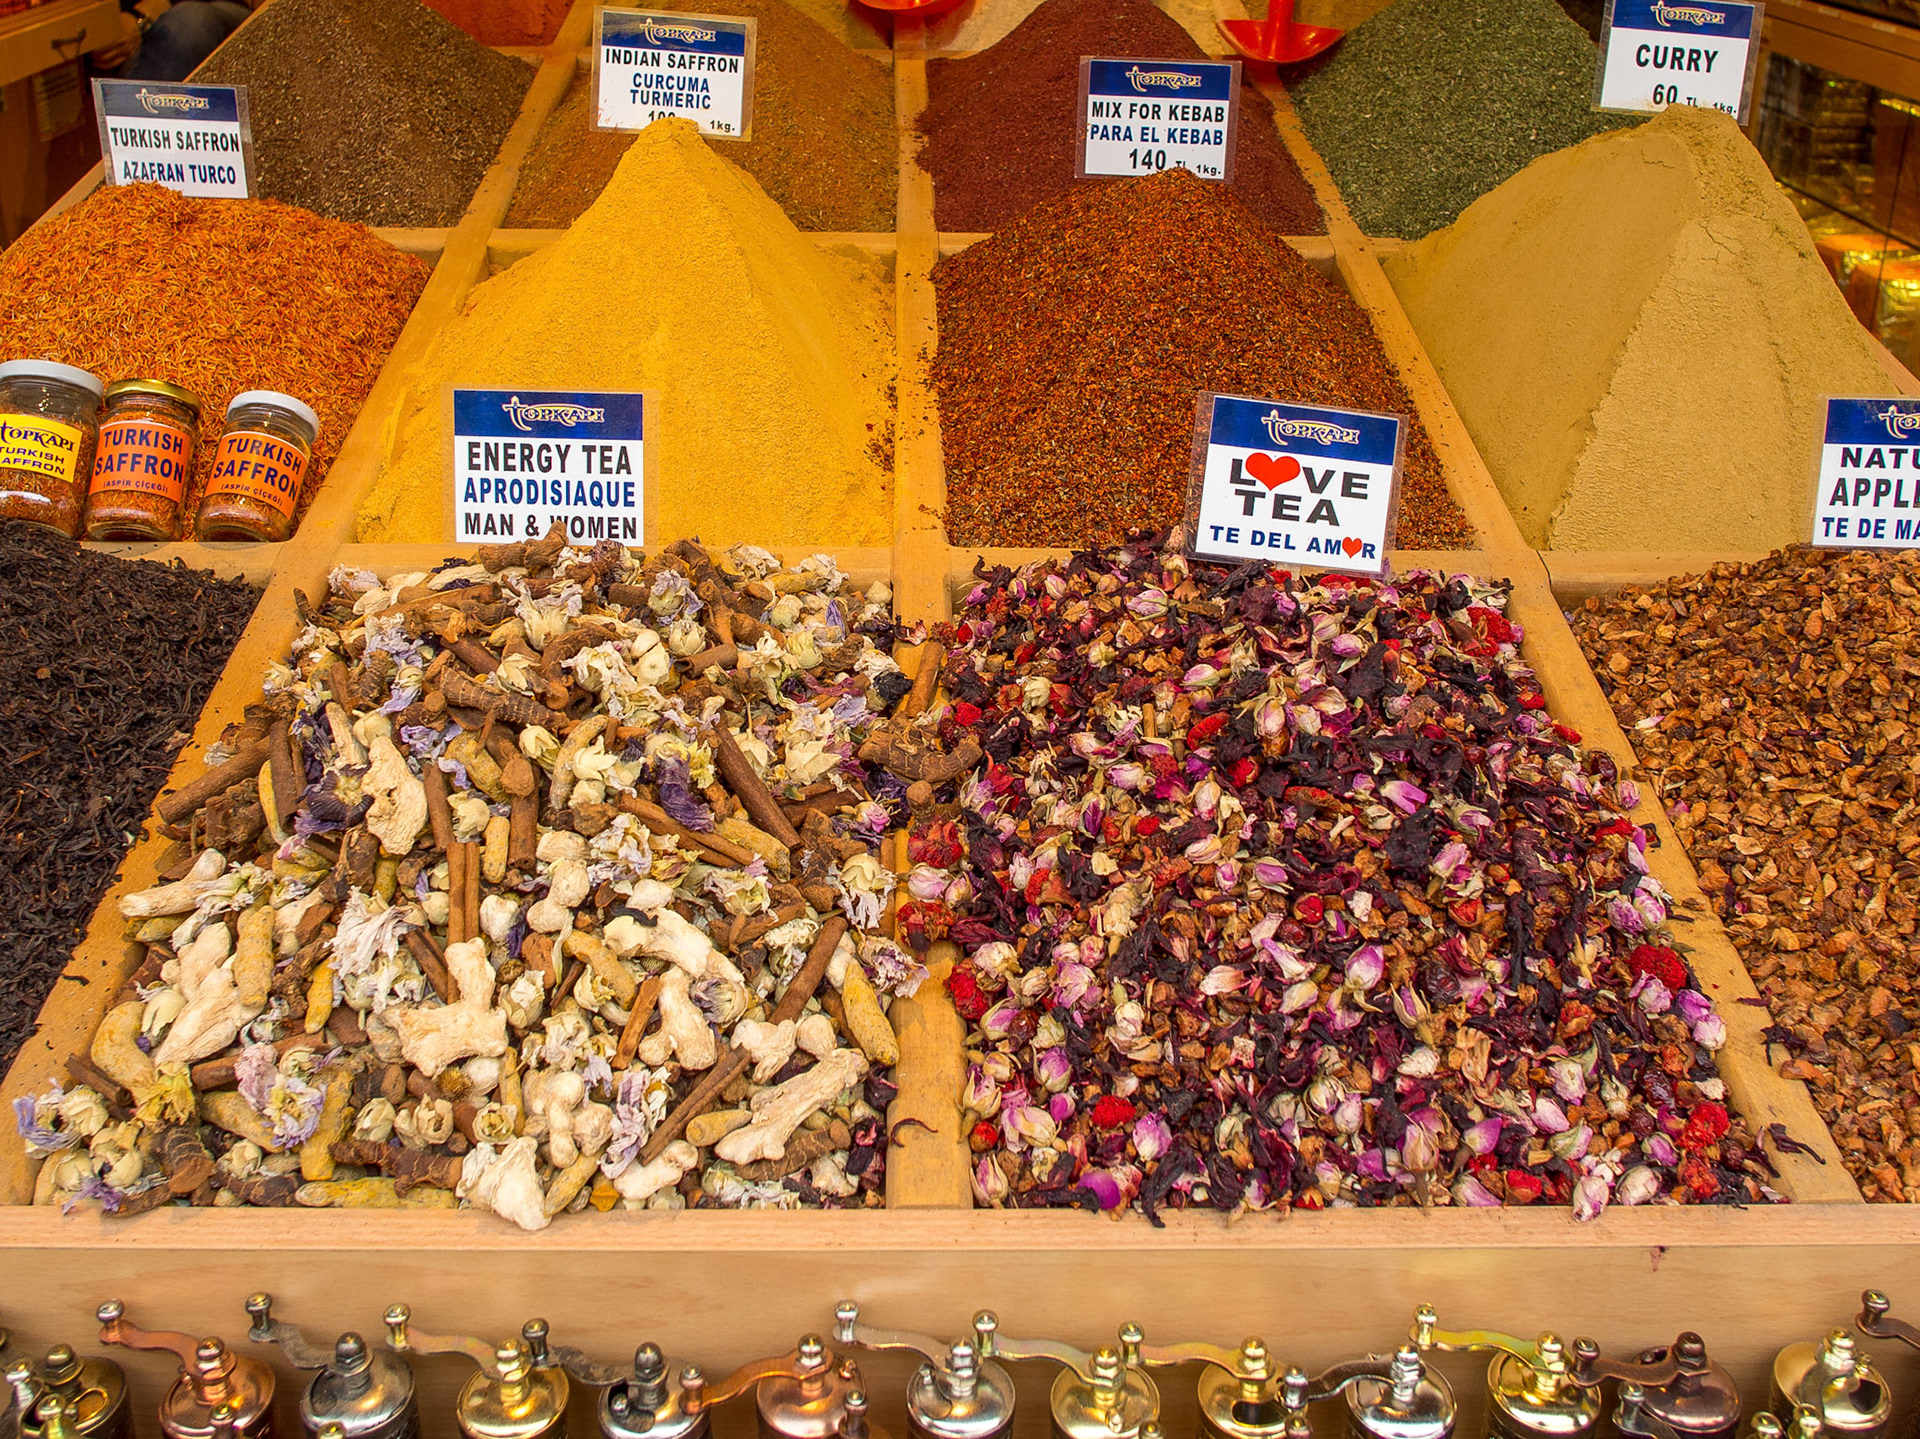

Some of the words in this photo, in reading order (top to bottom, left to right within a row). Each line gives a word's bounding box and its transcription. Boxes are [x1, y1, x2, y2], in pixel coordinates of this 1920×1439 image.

[605, 48, 661, 67] INDIAN
[667, 53, 738, 73] SAFFRON
[1636, 43, 1719, 73] CURRY
[633, 72, 710, 93] CURCUMA
[1653, 83, 1678, 105] 60
[630, 89, 711, 109] TURMERIC
[1092, 101, 1122, 119] MIX
[1129, 102, 1161, 120] FOR
[1168, 104, 1225, 123] KEBAB
[710, 120, 735, 133] 1kg.
[1090, 124, 1133, 142] PARA
[1140, 126, 1160, 143] EL
[1167, 127, 1223, 146] KEBAB
[110, 127, 171, 149] TURKISH
[176, 130, 240, 152] SAFFRON
[123, 160, 185, 182] AZAFRAN
[189, 164, 237, 185] TURCO
[1129, 148, 1167, 171] 140
[1196, 164, 1221, 176] 1kg.
[104, 428, 183, 455] TURKISH
[95, 453, 184, 484] SAFFRON
[227, 438, 302, 475] TURKISH
[467, 441, 571, 473] ENERGY
[581, 444, 632, 475] TEA
[213, 460, 298, 502] SAFFRON
[463, 477, 635, 509] APRODISIAQUE
[1234, 488, 1340, 527] TEA
[464, 512, 513, 536] MAN
[525, 514, 540, 537] &
[1822, 517, 1849, 538] TE
[1857, 518, 1886, 538] DE
[1210, 525, 1240, 544] TE
[1250, 529, 1296, 551] DEL
